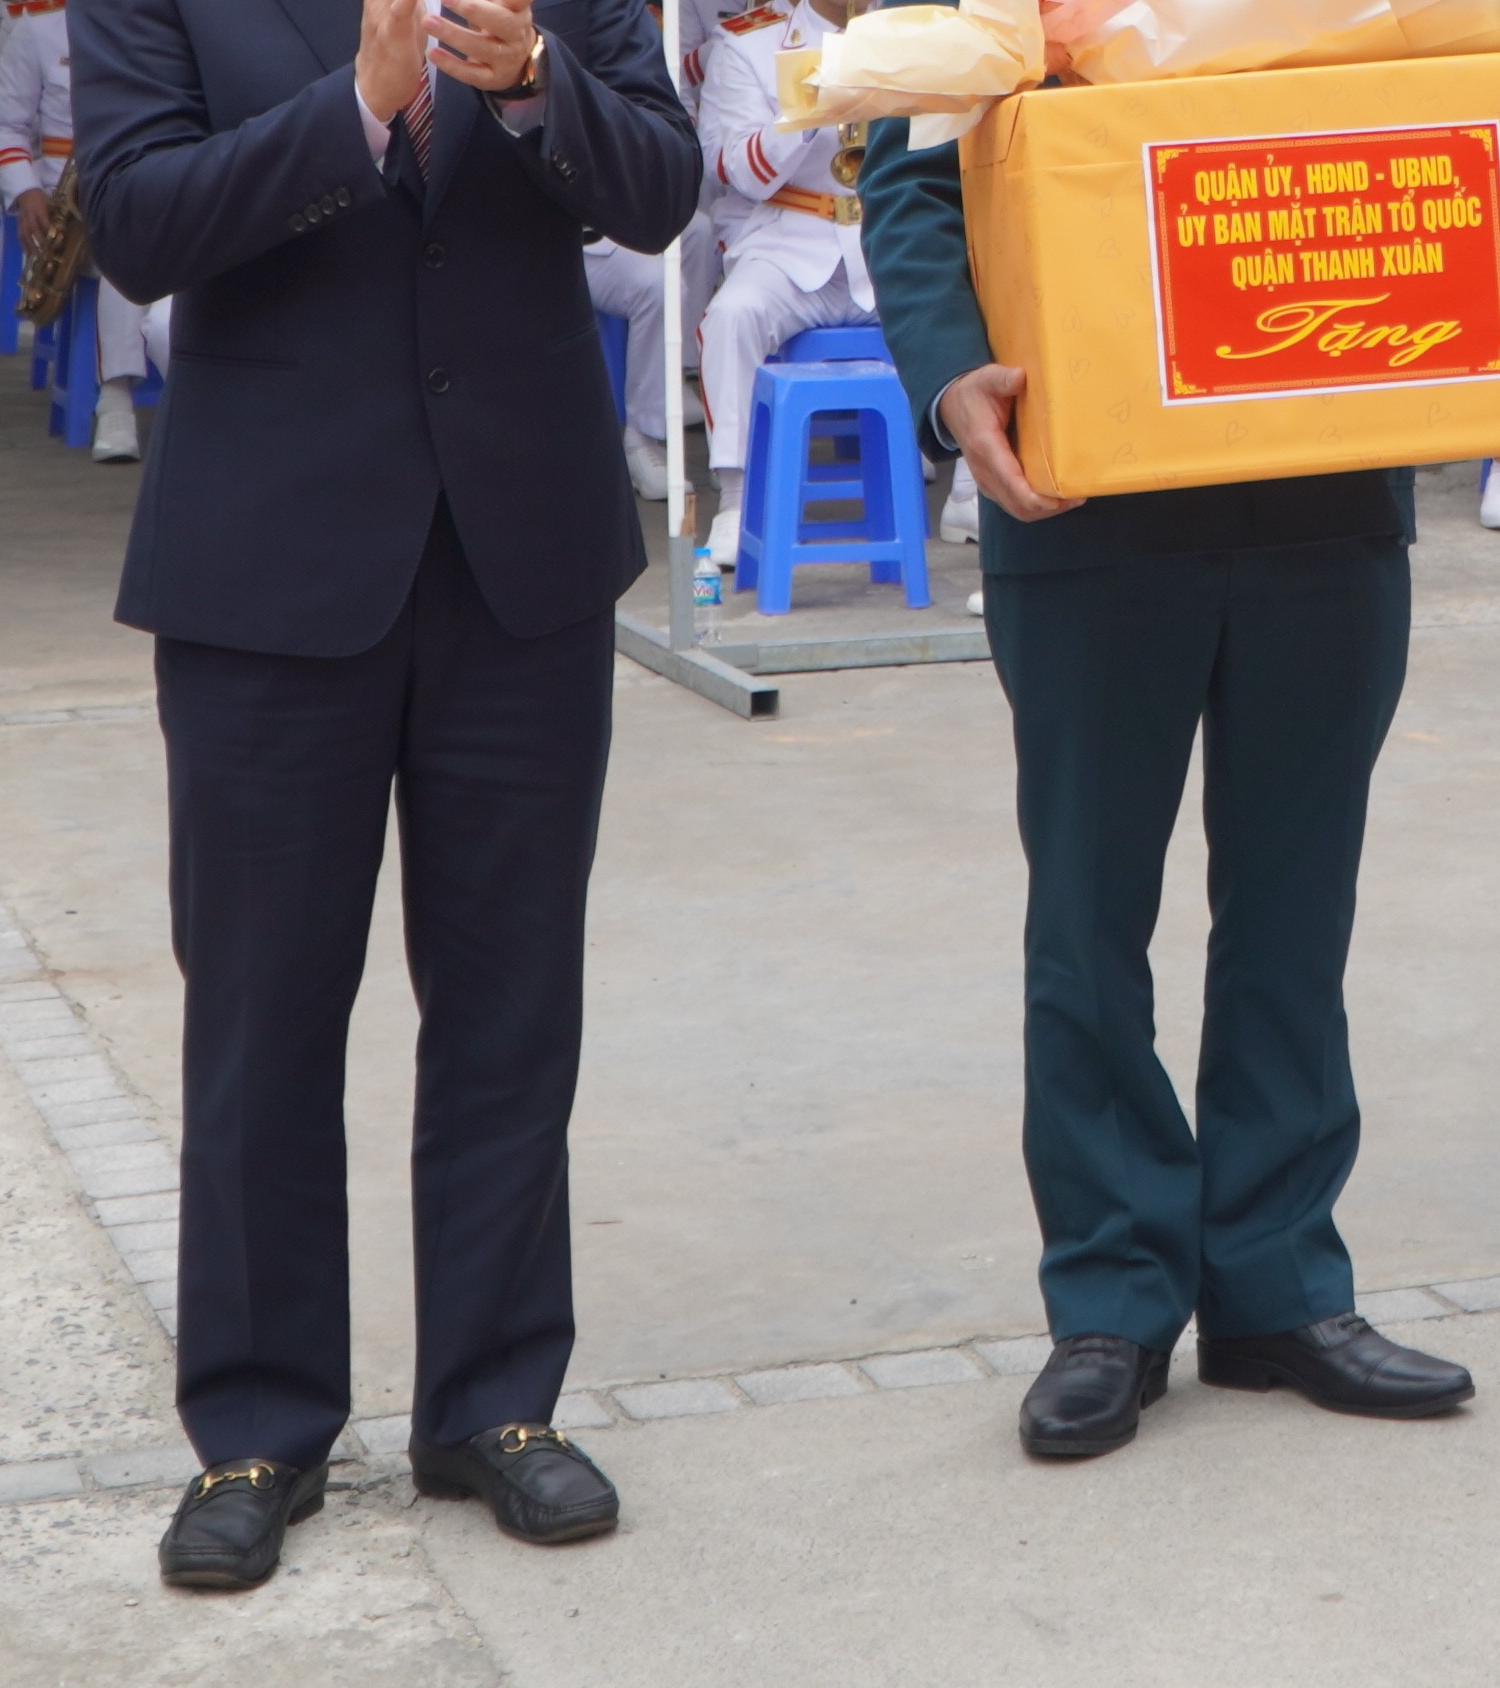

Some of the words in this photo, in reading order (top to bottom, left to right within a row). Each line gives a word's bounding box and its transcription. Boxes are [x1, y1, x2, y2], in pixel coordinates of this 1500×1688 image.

[1195, 164, 1258, 207] QUẬN
[1264, 154, 1300, 199] ỦY,
[1306, 161, 1368, 195] HĐND
[1390, 155, 1460, 188] UBND,
[1177, 204, 1206, 247] ỦY
[1214, 212, 1262, 245] BAN
[1268, 203, 1316, 246] MẶT
[1322, 199, 1383, 242] TRẬN
[1388, 189, 1416, 232] TỔ
[1422, 187, 1482, 233] QUỐC
[1231, 248, 1294, 292] QUẬN
[1300, 248, 1375, 282] THANH
[1380, 238, 1443, 277] XUÂN
[1216, 293, 1462, 367] Tặng
